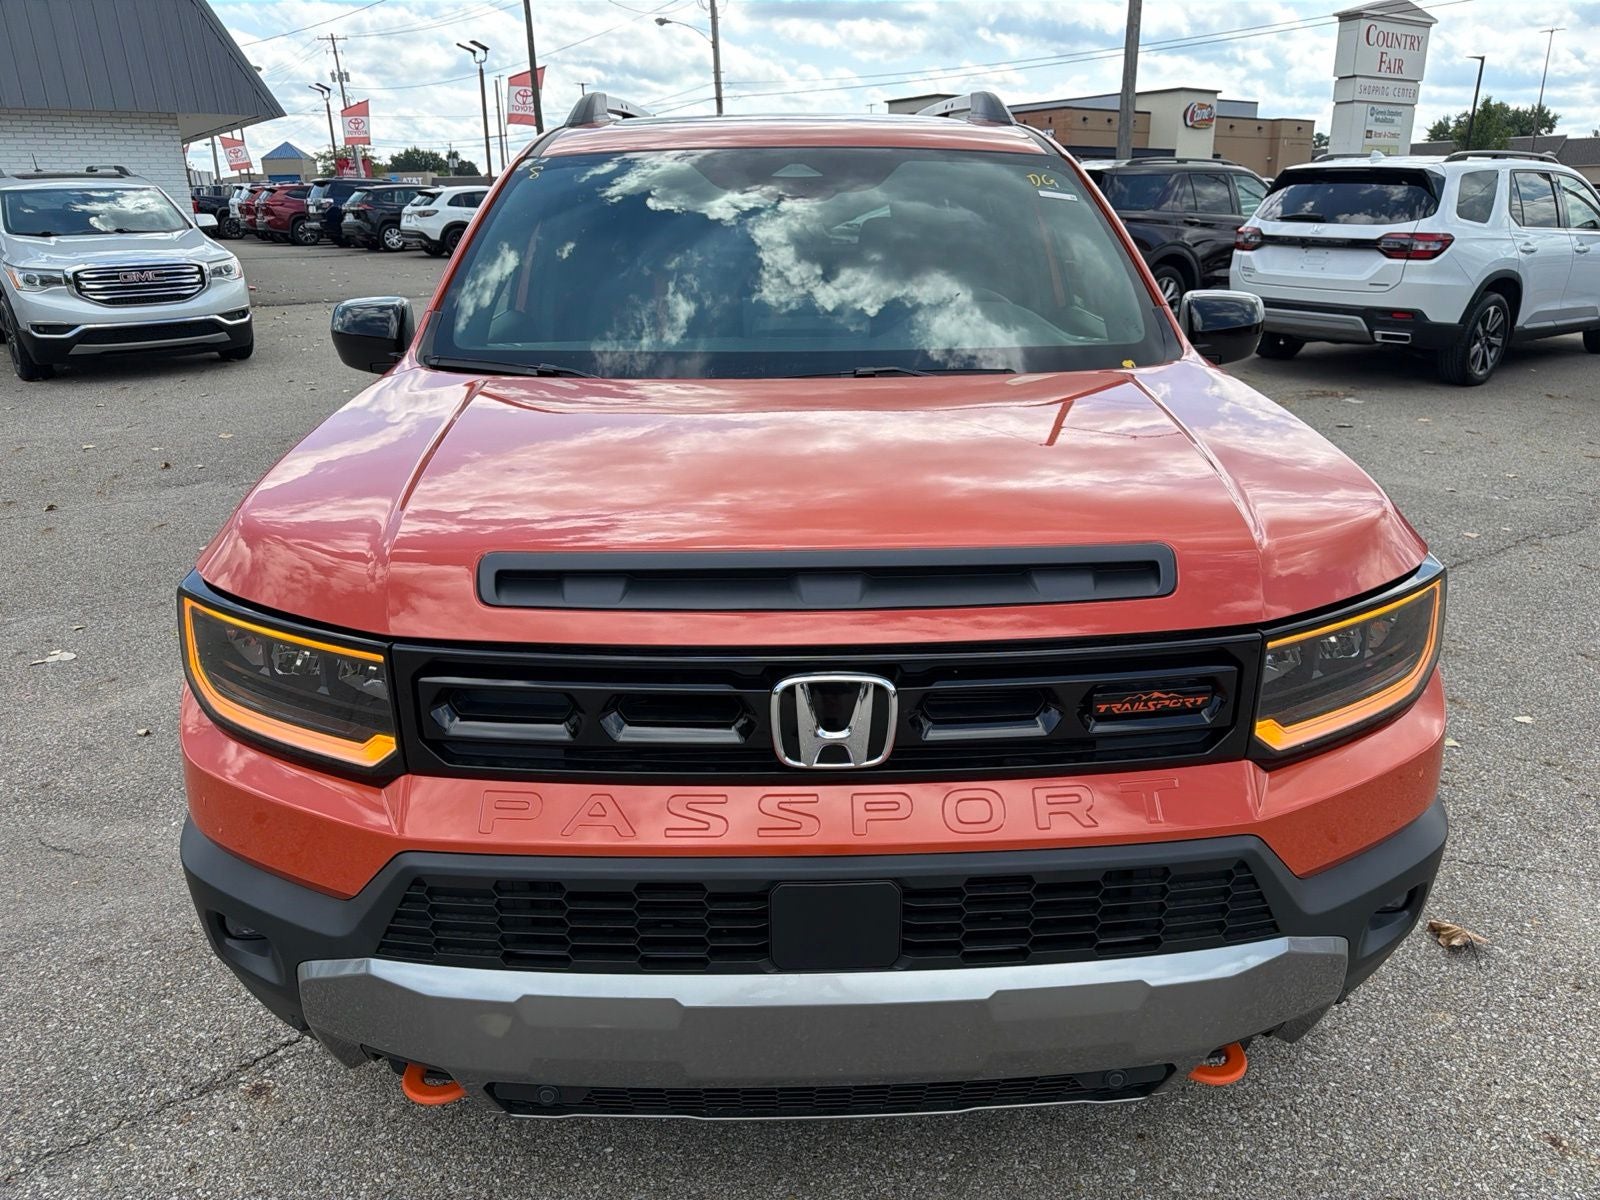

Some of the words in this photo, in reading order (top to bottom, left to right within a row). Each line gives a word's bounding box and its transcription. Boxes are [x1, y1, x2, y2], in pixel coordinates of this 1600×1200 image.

[1365, 23, 1424, 52] COUNTRY
[1377, 51, 1404, 75] FAIR
[1359, 84, 1390, 97] SHOPPING
[1392, 87, 1417, 98] CENTER
[402, 176, 423, 185] AT&T
[119, 271, 166, 282] GMC
[1096, 696, 1209, 714] TRAILSPORT
[477, 777, 1180, 839] PASSPORT
